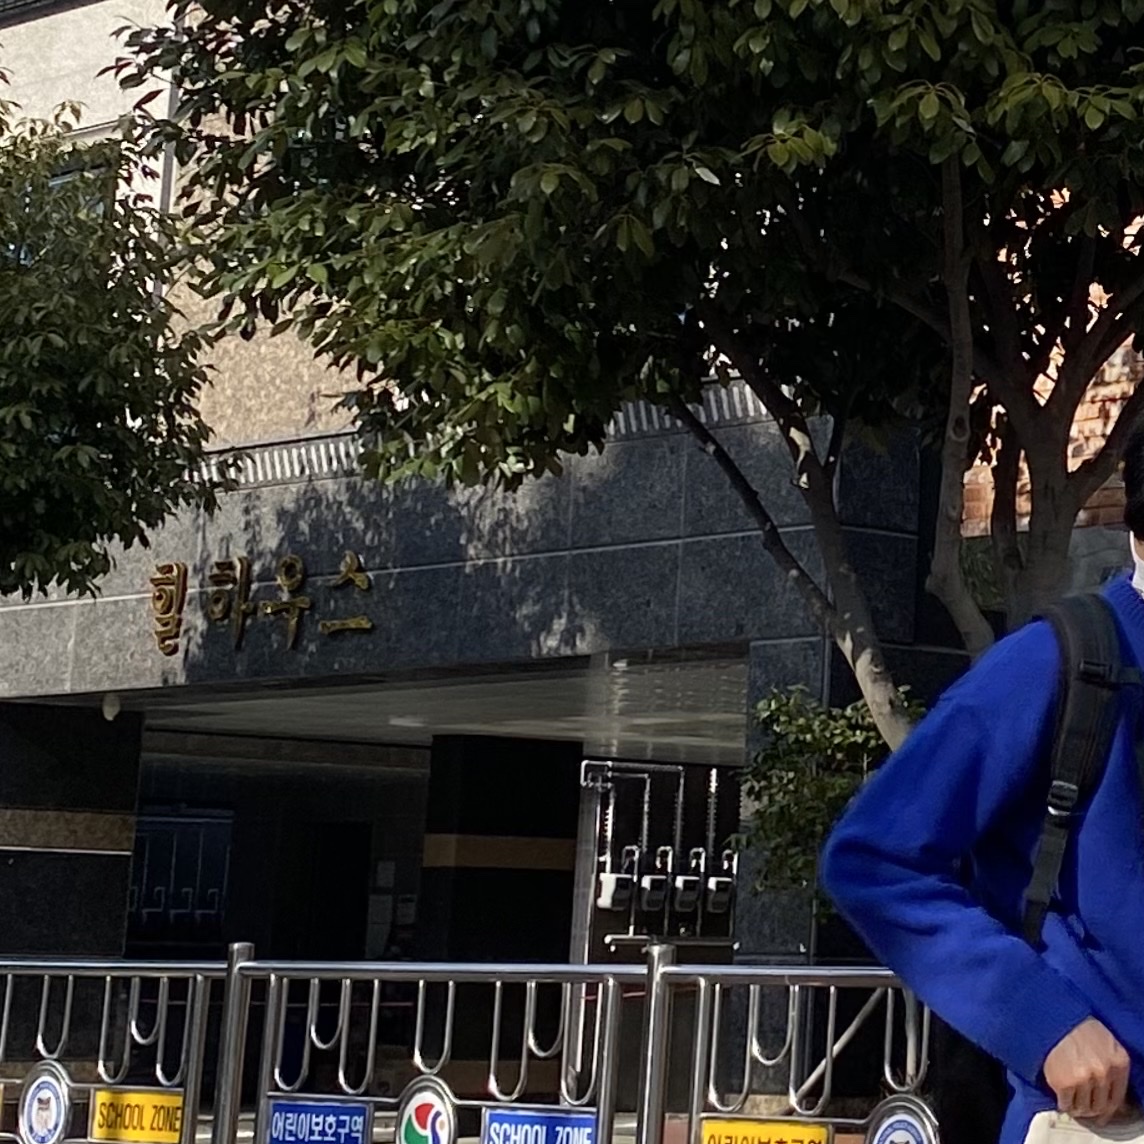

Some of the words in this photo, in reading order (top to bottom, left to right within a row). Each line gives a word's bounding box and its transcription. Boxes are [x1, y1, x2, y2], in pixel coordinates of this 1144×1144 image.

[150, 551, 374, 656] 힐하우스
[98, 1102, 145, 1132] SCHOOL
[150, 1105, 182, 1132] ZONE
[271, 1111, 365, 1144] 어린이보호구역
